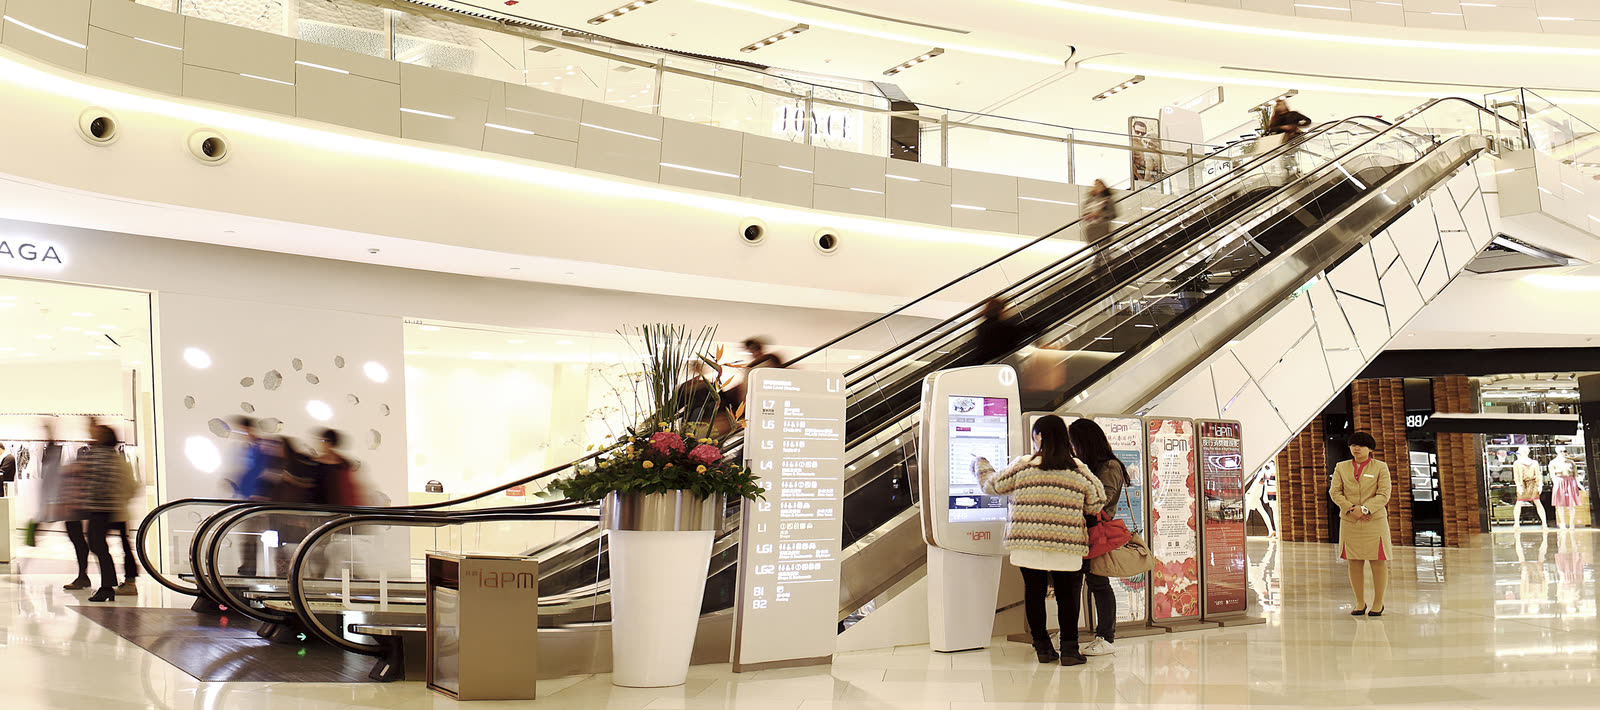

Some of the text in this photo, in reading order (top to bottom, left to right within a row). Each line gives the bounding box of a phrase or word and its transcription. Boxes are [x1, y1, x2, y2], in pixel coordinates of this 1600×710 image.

[0, 240, 62, 264] AGA
[762, 400, 776, 409] L7
[762, 420, 775, 430] L6
[761, 440, 774, 450] L5
[760, 460, 773, 470] L4
[758, 502, 772, 512] L2
[755, 564, 775, 575] LG2
